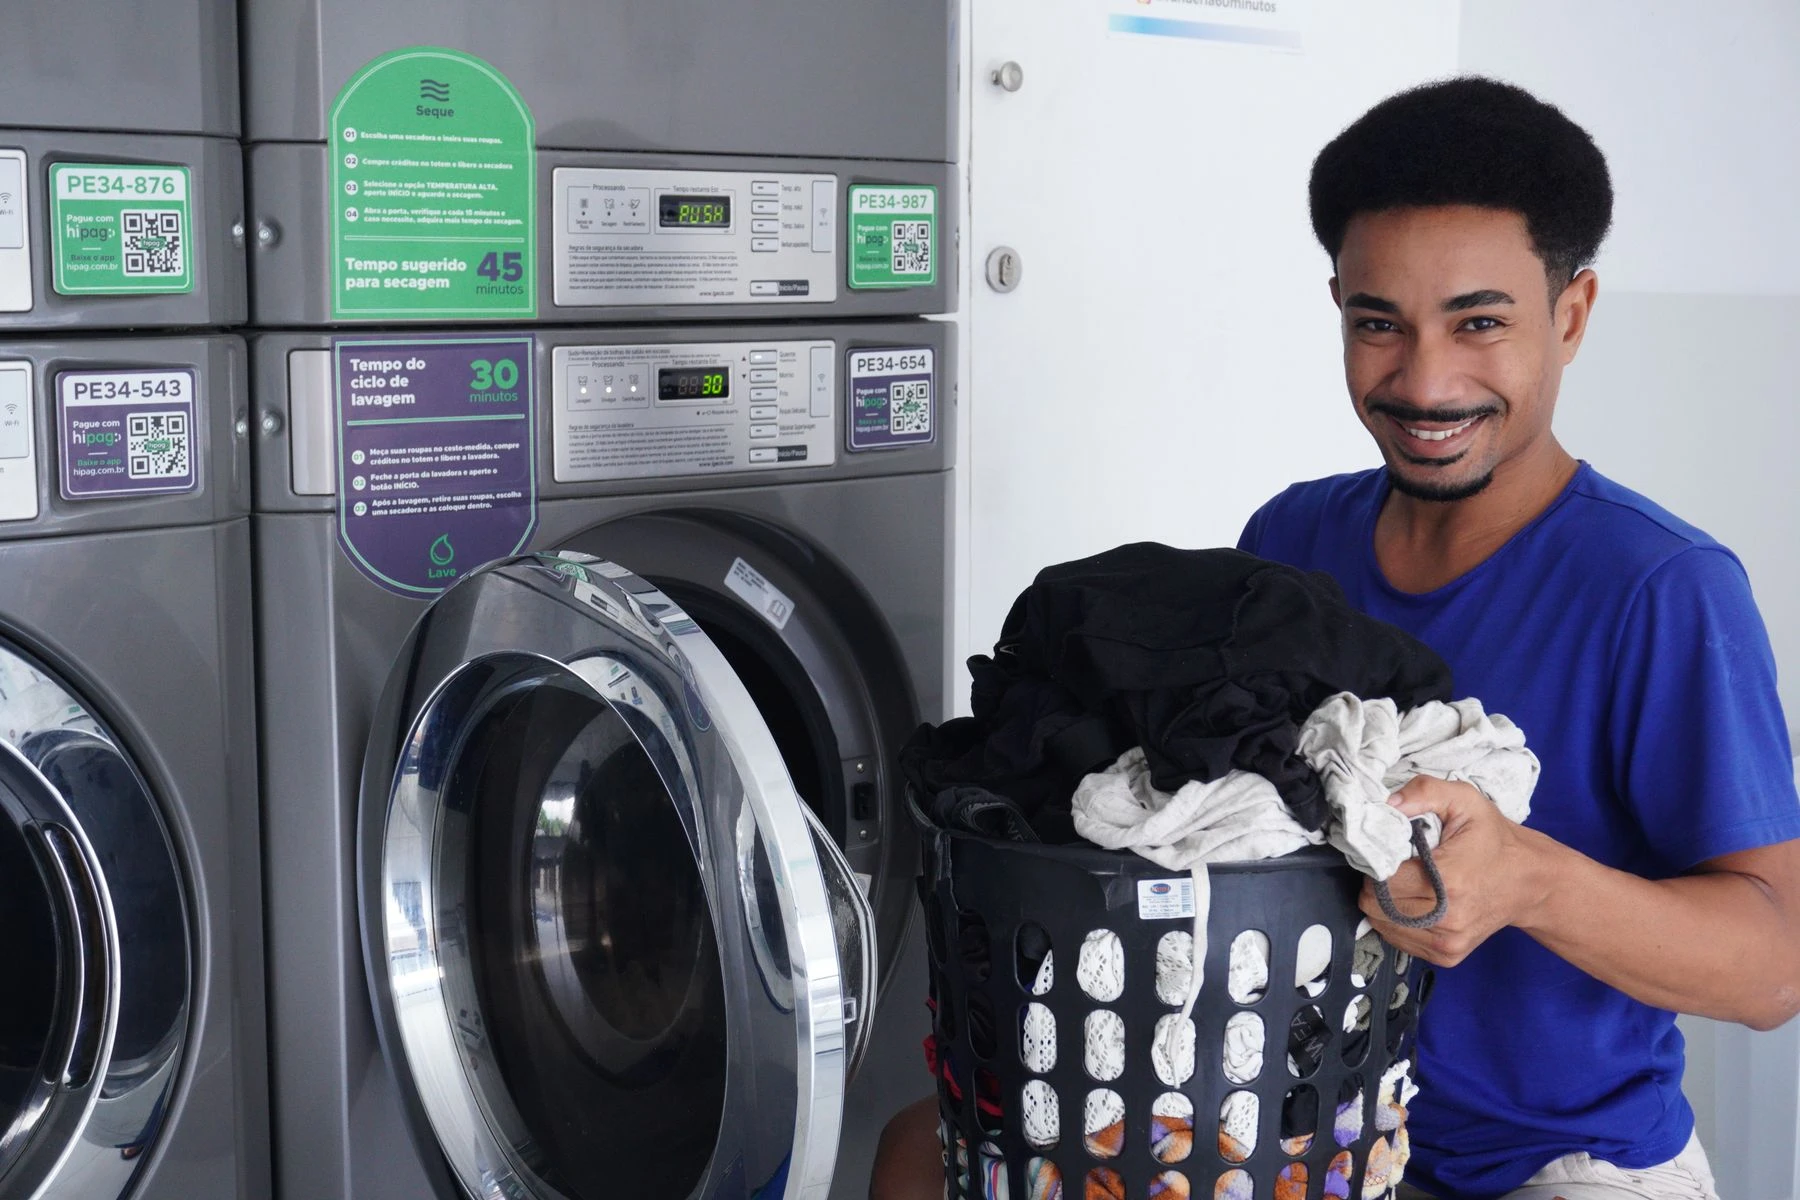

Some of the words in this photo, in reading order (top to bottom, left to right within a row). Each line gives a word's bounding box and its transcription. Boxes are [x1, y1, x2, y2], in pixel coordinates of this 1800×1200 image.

[416, 105, 455, 119] Seque
[361, 131, 388, 140] Escolha
[442, 134, 462, 142] insira
[362, 158, 390, 167] Compre
[391, 158, 419, 167] créditos
[430, 160, 451, 168] totem
[457, 160, 477, 169] libere
[483, 162, 513, 170] secadora
[67, 175, 175, 194] PE34-876
[363, 180, 397, 188] Selecione
[404, 181, 425, 189] opção
[426, 182, 478, 190] TEMPERATURA
[363, 190, 387, 198] aperte
[417, 191, 445, 199] aguarde
[859, 194, 928, 209] PE34-987
[364, 207, 382, 215] Abra
[410, 208, 442, 216] verifique
[473, 209, 501, 217] minutos
[679, 204, 724, 224] PUSH
[66, 214, 94, 224] Pague
[95, 215, 114, 223] com
[444, 216, 460, 224] mais
[461, 217, 483, 225] tempo
[100, 255, 115, 263] app
[66, 262, 119, 271] hipag.com.br
[345, 257, 398, 273] Tempo
[401, 257, 467, 274] sugerido
[476, 252, 524, 282] 45
[345, 277, 380, 290] para
[383, 277, 450, 290] secagem
[476, 283, 524, 295] minutos
[857, 355, 926, 372] PE34-654
[350, 358, 402, 373] Tempo
[406, 357, 426, 370] do
[470, 359, 518, 390] 30
[351, 375, 386, 389] ciclo
[390, 375, 409, 388] de
[702, 374, 724, 394] 30
[74, 379, 181, 400] PE34-543
[351, 393, 416, 407] lavagem
[469, 391, 518, 403] minutos
[73, 420, 100, 429] Pague
[102, 420, 120, 428] com
[369, 448, 389, 456] Meça
[408, 447, 433, 455] roupas
[444, 443, 493, 452] cesto-medida,
[77, 458, 98, 466] Baixe
[107, 458, 122, 466] app
[370, 457, 400, 465] créditos
[440, 454, 461, 462] libere
[467, 453, 500, 461] lavadora.
[73, 467, 125, 476] hipag.com.br
[400, 472, 419, 480] porta
[431, 469, 462, 477] lavadora
[469, 468, 492, 476] aperte
[370, 482, 393, 491] botão
[393, 481, 420, 490] INÍCIO.
[372, 499, 391, 507] Após
[398, 497, 431, 505] lavagem,
[432, 495, 452, 503] retire
[469, 493, 495, 501] roupas,
[496, 491, 522, 499] escolha
[389, 507, 422, 515] secadora
[438, 504, 466, 512] coloque
[428, 567, 457, 579] Lave
